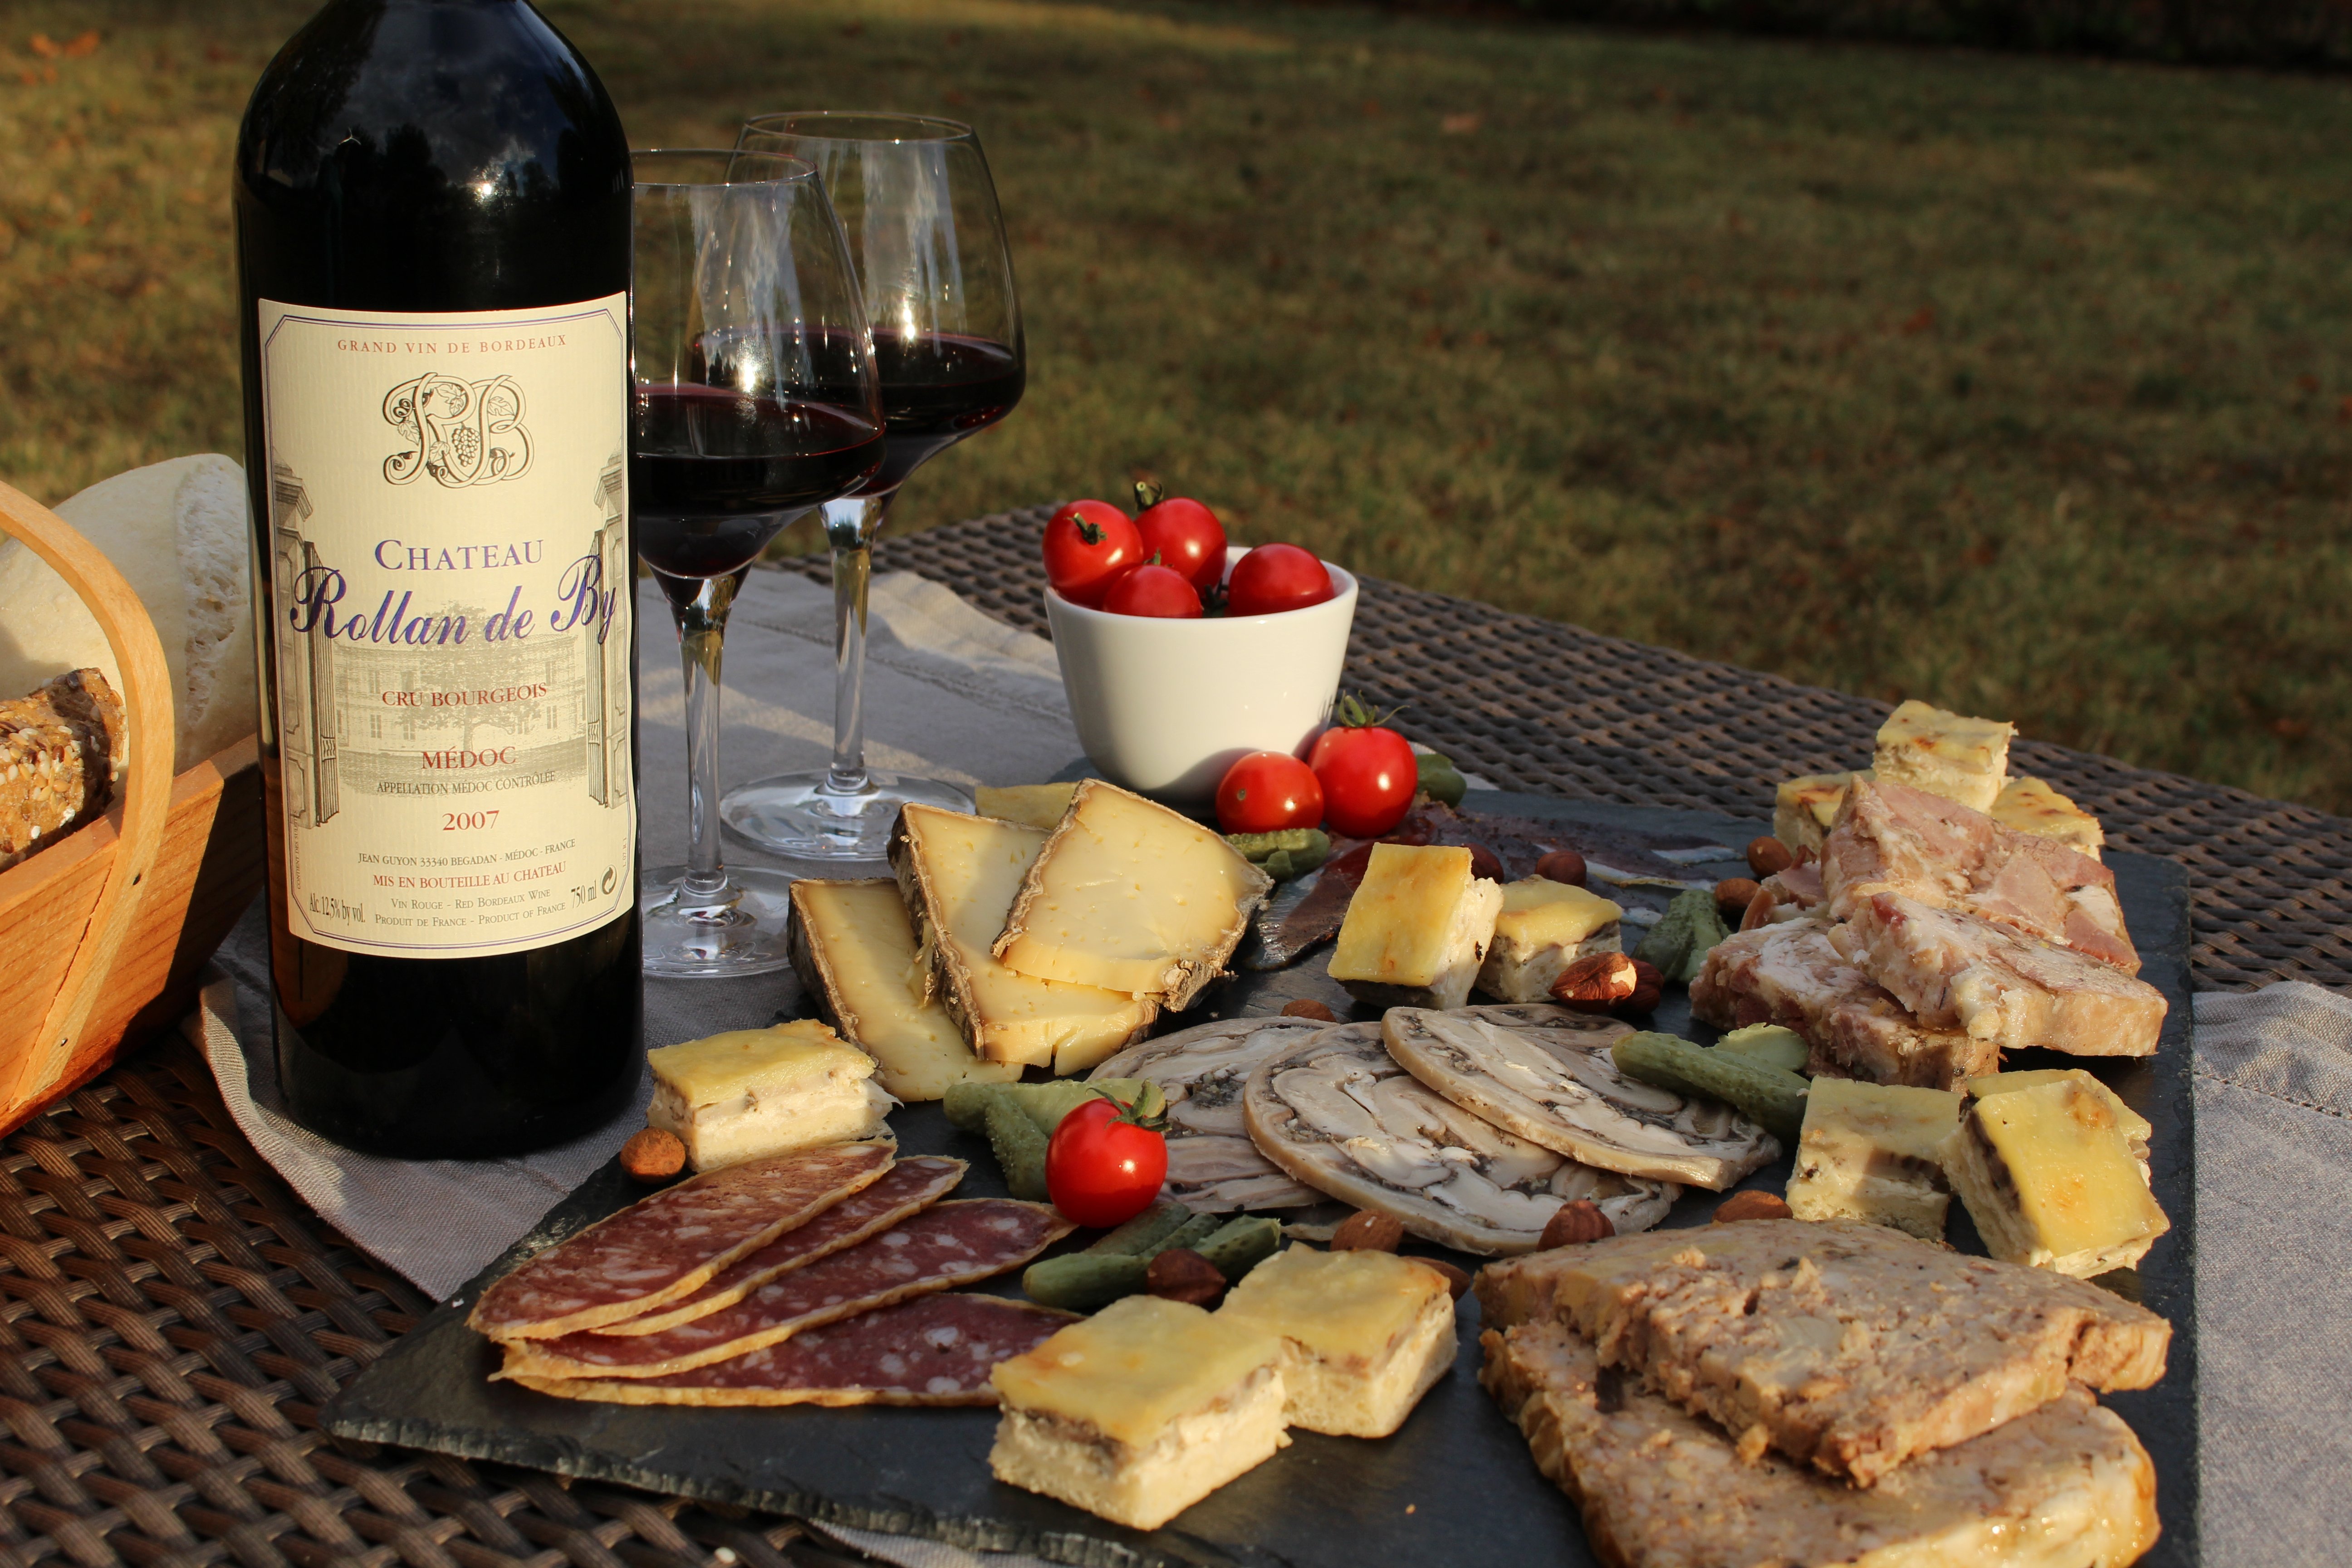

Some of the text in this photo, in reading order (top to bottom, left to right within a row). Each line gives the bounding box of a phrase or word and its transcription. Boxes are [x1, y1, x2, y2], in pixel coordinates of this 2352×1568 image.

[338, 334, 567, 354] GRAND VIN DE BORDEAUX
[375, 539, 544, 570] CHATEAU
[289, 554, 617, 645] Rollan de By
[382, 682, 548, 707] CRU BOURGEOIS
[421, 745, 516, 769] MÉDOC
[377, 769, 556, 794] APPELLATION MÉDOC CONTRÔLÉE
[442, 810, 500, 831] 2007
[358, 853, 380, 864] JEAN
[382, 854, 417, 866] GUYON
[420, 857, 448, 867] 33340
[451, 853, 497, 866] BEGADAN
[505, 848, 539, 862] MÉDOC
[545, 838, 576, 855] FRANCE
[373, 861, 566, 889] MIS EN BOUTEILLE AU CHATEAU
[571, 880, 597, 909] 750 ml
[310, 892, 366, 926] Alc. 12,5% by vol.
